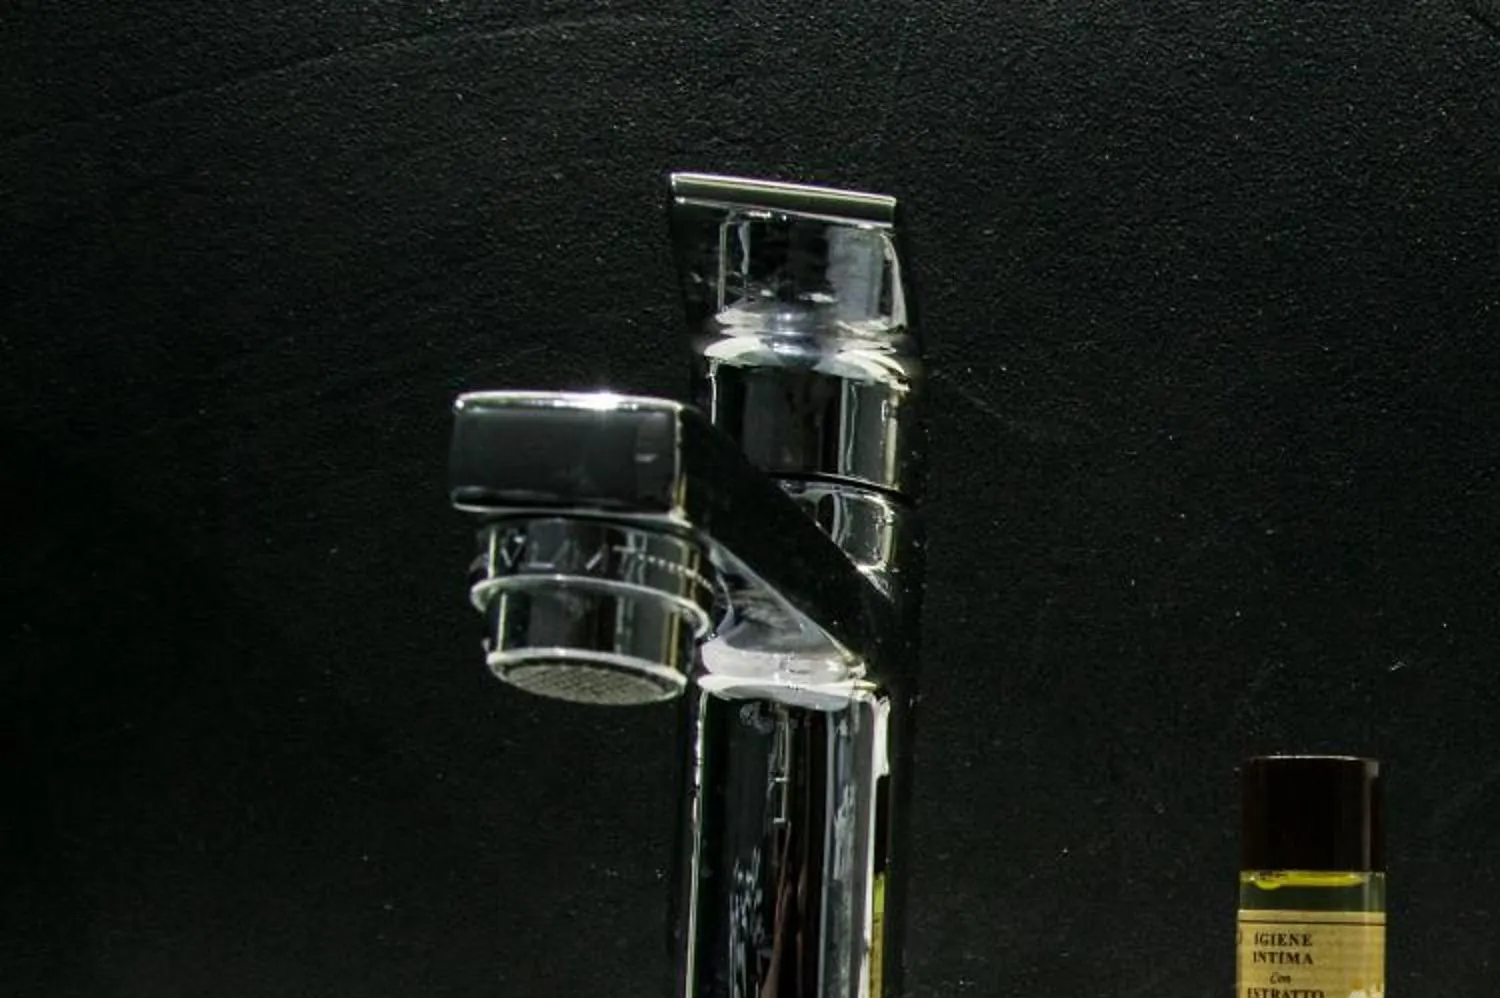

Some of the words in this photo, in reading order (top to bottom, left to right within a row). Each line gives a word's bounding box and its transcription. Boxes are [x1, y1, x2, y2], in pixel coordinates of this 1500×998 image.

[1253, 932, 1313, 947] IGIENE
[1252, 951, 1314, 965] INTIMA
[1269, 971, 1292, 985] Con
